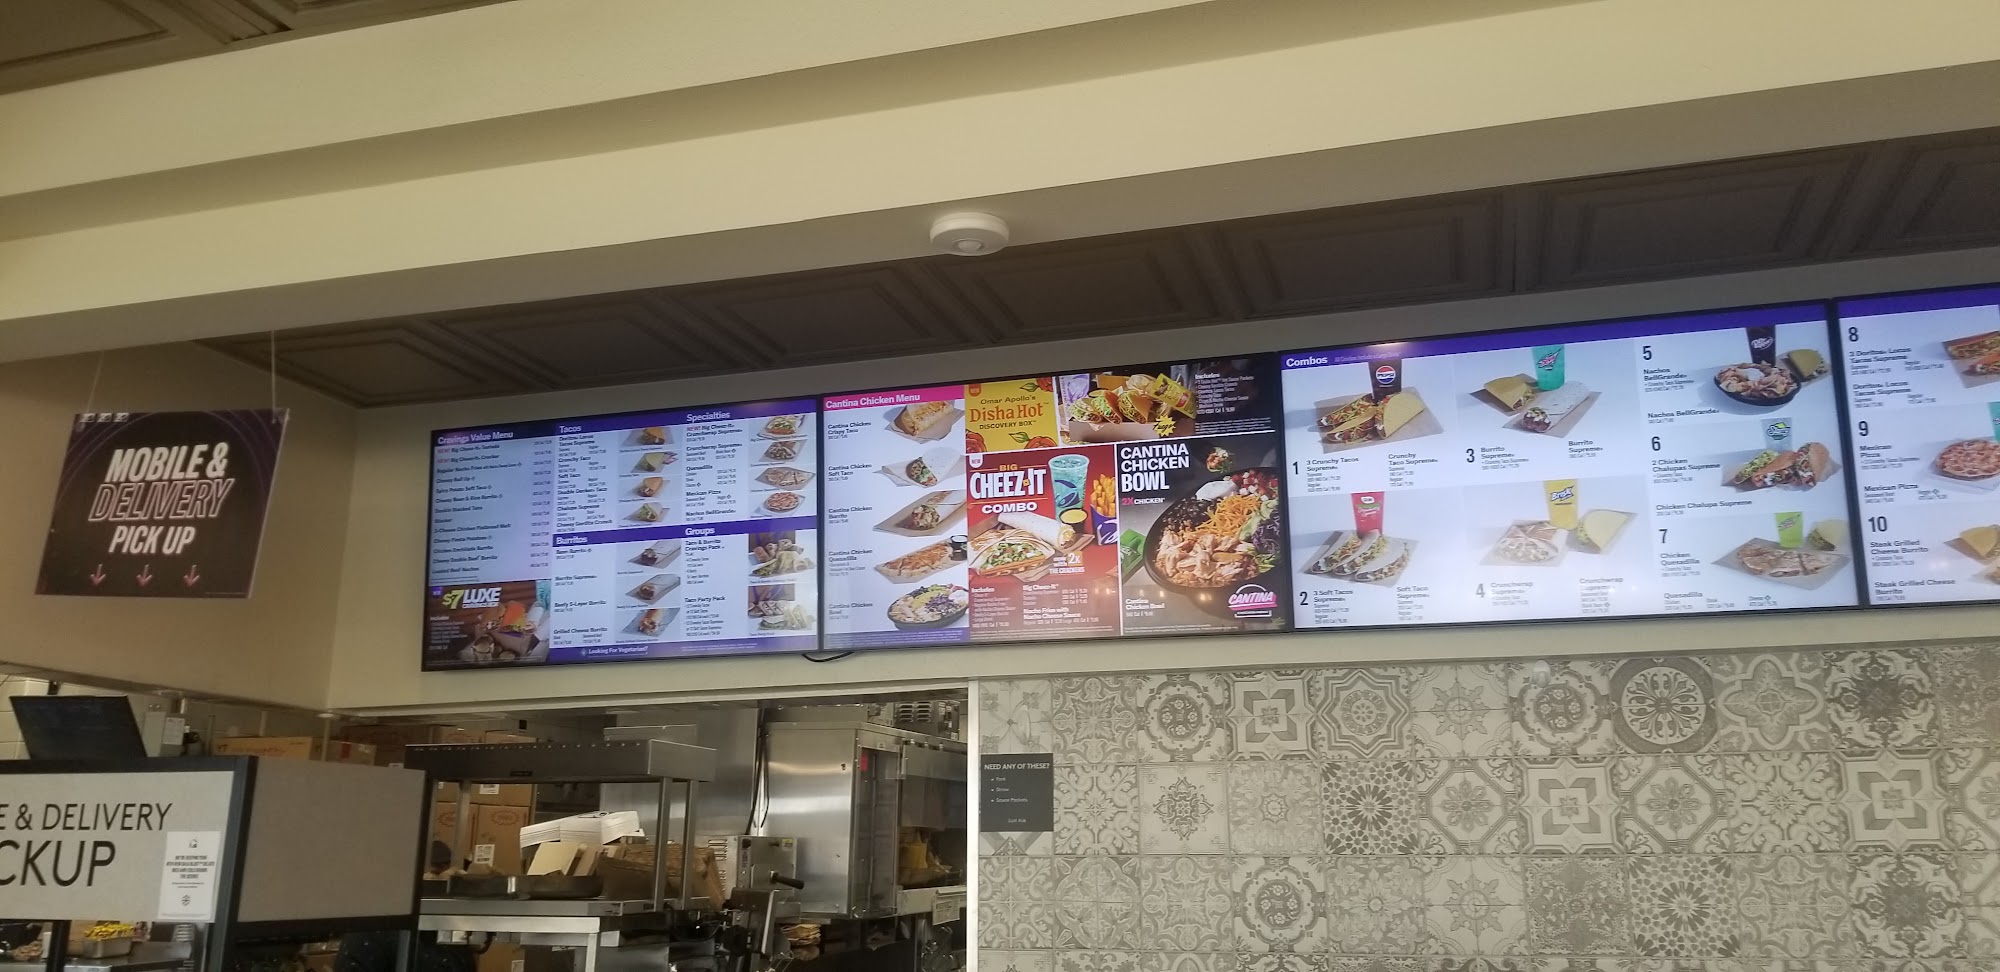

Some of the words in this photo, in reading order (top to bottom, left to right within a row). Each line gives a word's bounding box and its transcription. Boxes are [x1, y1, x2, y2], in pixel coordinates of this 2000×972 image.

[1849, 327, 1859, 342] 8
[1643, 346, 1652, 360] 5
[1286, 356, 1328, 367] Combos
[826, 400, 858, 409] Cantina
[860, 396, 894, 405] Chicken
[896, 394, 920, 402] Menu
[1004, 395, 1036, 403] Apollo's
[687, 411, 730, 422] Specialties
[970, 406, 1014, 422] Disha
[1017, 403, 1043, 418] Hot
[1858, 421, 1869, 436] 9
[1652, 436, 1661, 451] 6
[1121, 444, 1189, 459] CANTINA
[1466, 448, 1475, 463] 3
[104, 444, 208, 482] MOBILE
[206, 442, 229, 478] &
[1121, 456, 1189, 472] CHICKEN
[1293, 461, 1298, 474] 1
[1652, 464, 1687, 472] Chalupas
[1122, 471, 1169, 492] BOWL
[88, 478, 235, 521] DELIVERY
[1656, 503, 1686, 511] Chicken
[982, 502, 1037, 514] COMBO
[685, 527, 715, 536] Groups
[1868, 516, 1887, 532] 10
[108, 526, 163, 553] PICK
[162, 526, 196, 554] UP
[556, 536, 587, 544] Burritos
[1659, 529, 1668, 544] 7
[442, 590, 464, 609] $7
[463, 587, 502, 602] LUXE
[1228, 592, 1274, 604] CANTINA
[1476, 583, 1485, 598] 4
[1300, 592, 1308, 605] 2
[15, 804, 32, 831] &
[42, 803, 172, 831] DELIVERY
